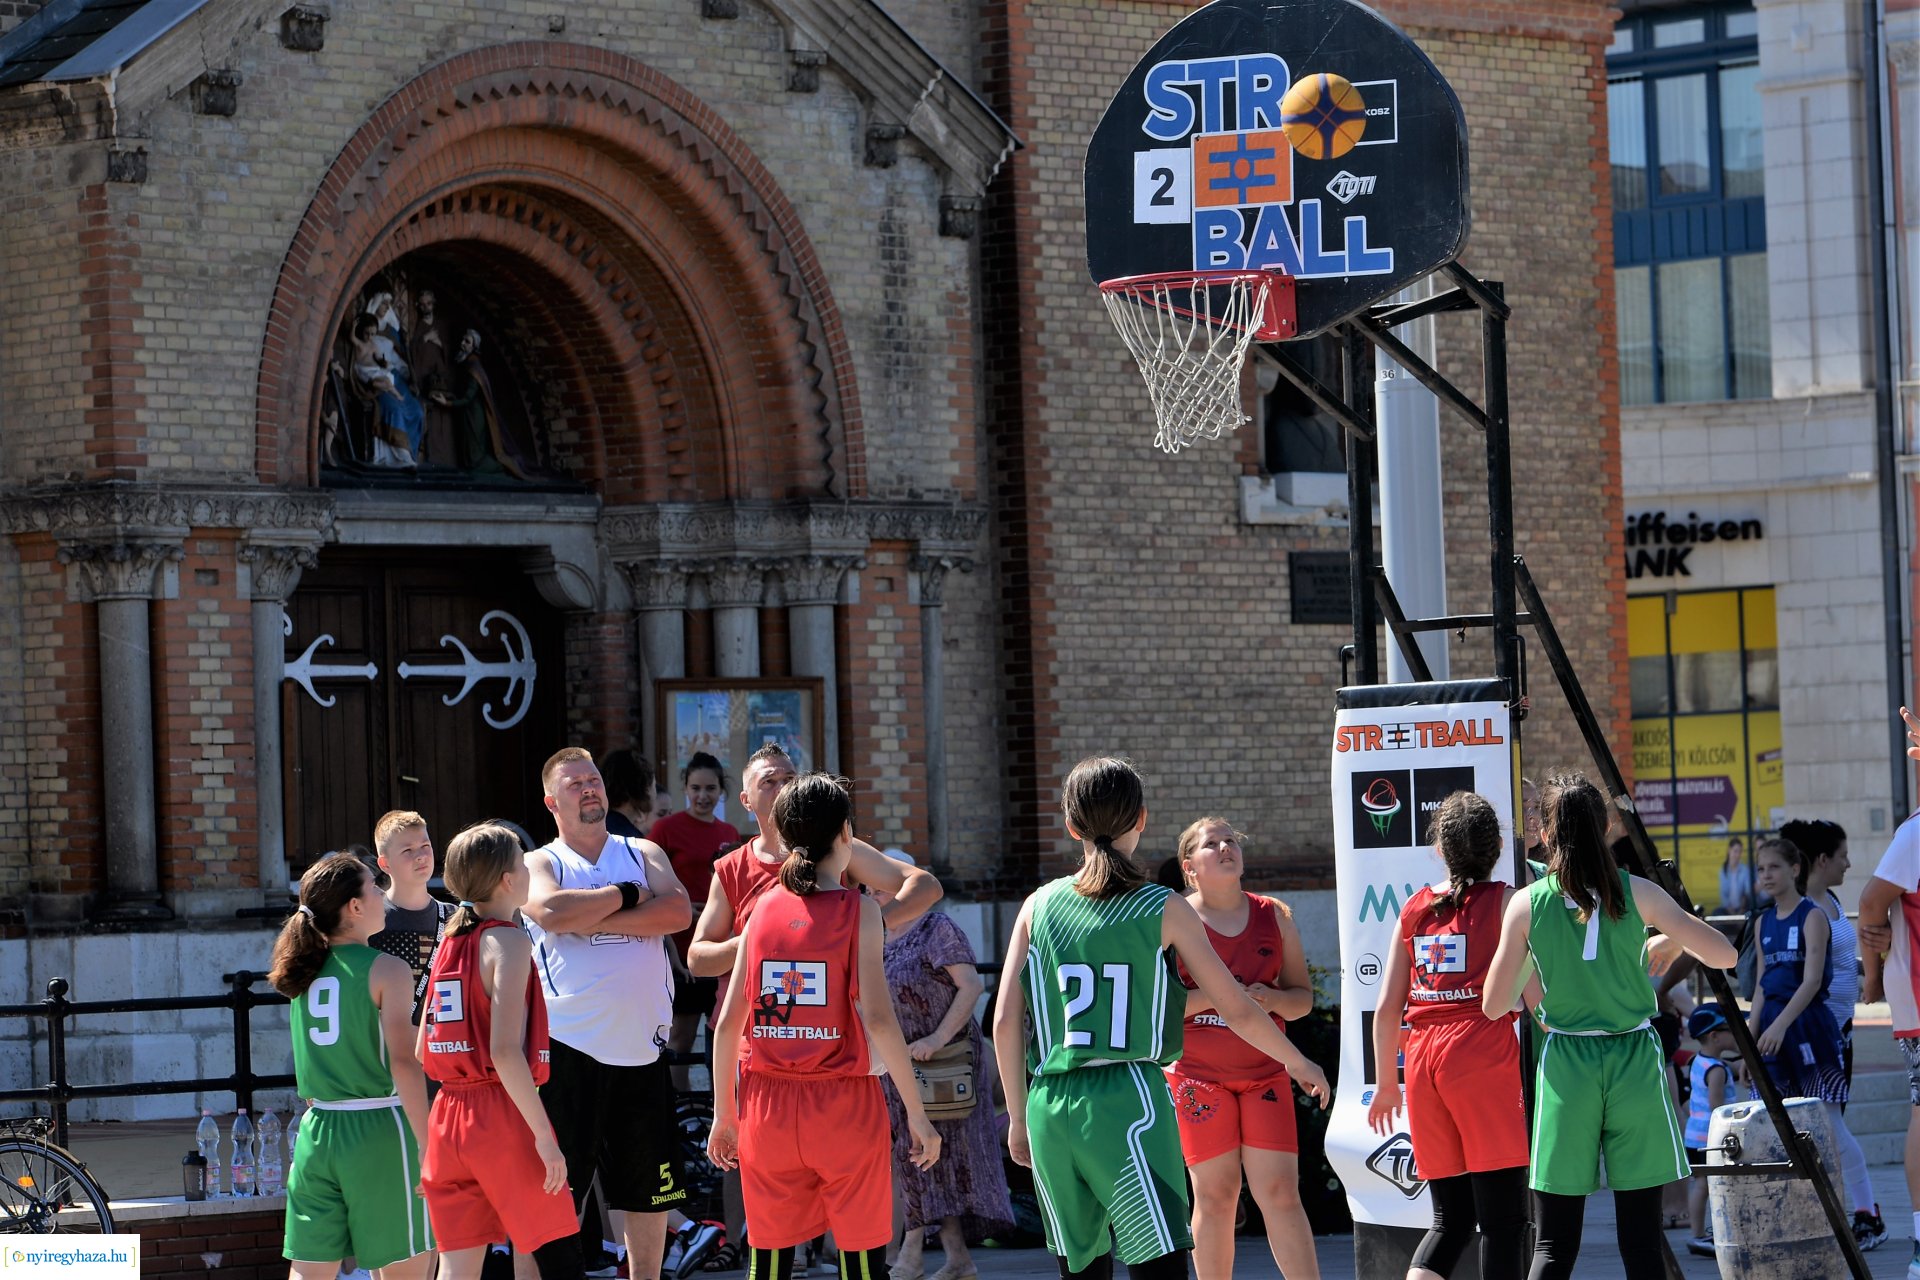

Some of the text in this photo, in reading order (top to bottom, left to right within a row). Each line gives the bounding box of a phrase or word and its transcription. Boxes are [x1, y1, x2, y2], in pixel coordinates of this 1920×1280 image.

[1149, 167, 1175, 206] 2
[1192, 198, 1394, 280] BALL
[1382, 369, 1395, 380] 36
[1625, 511, 1763, 546] iffeisen
[1336, 718, 1503, 753] STREETBALL
[307, 975, 340, 1046] 9
[1057, 962, 1133, 1052] 21
[1410, 987, 1478, 1002] STREETBALL
[752, 1025, 841, 1040] STREETBALL
[659, 1162, 674, 1192] 5
[651, 1189, 687, 1205] SPALDING
